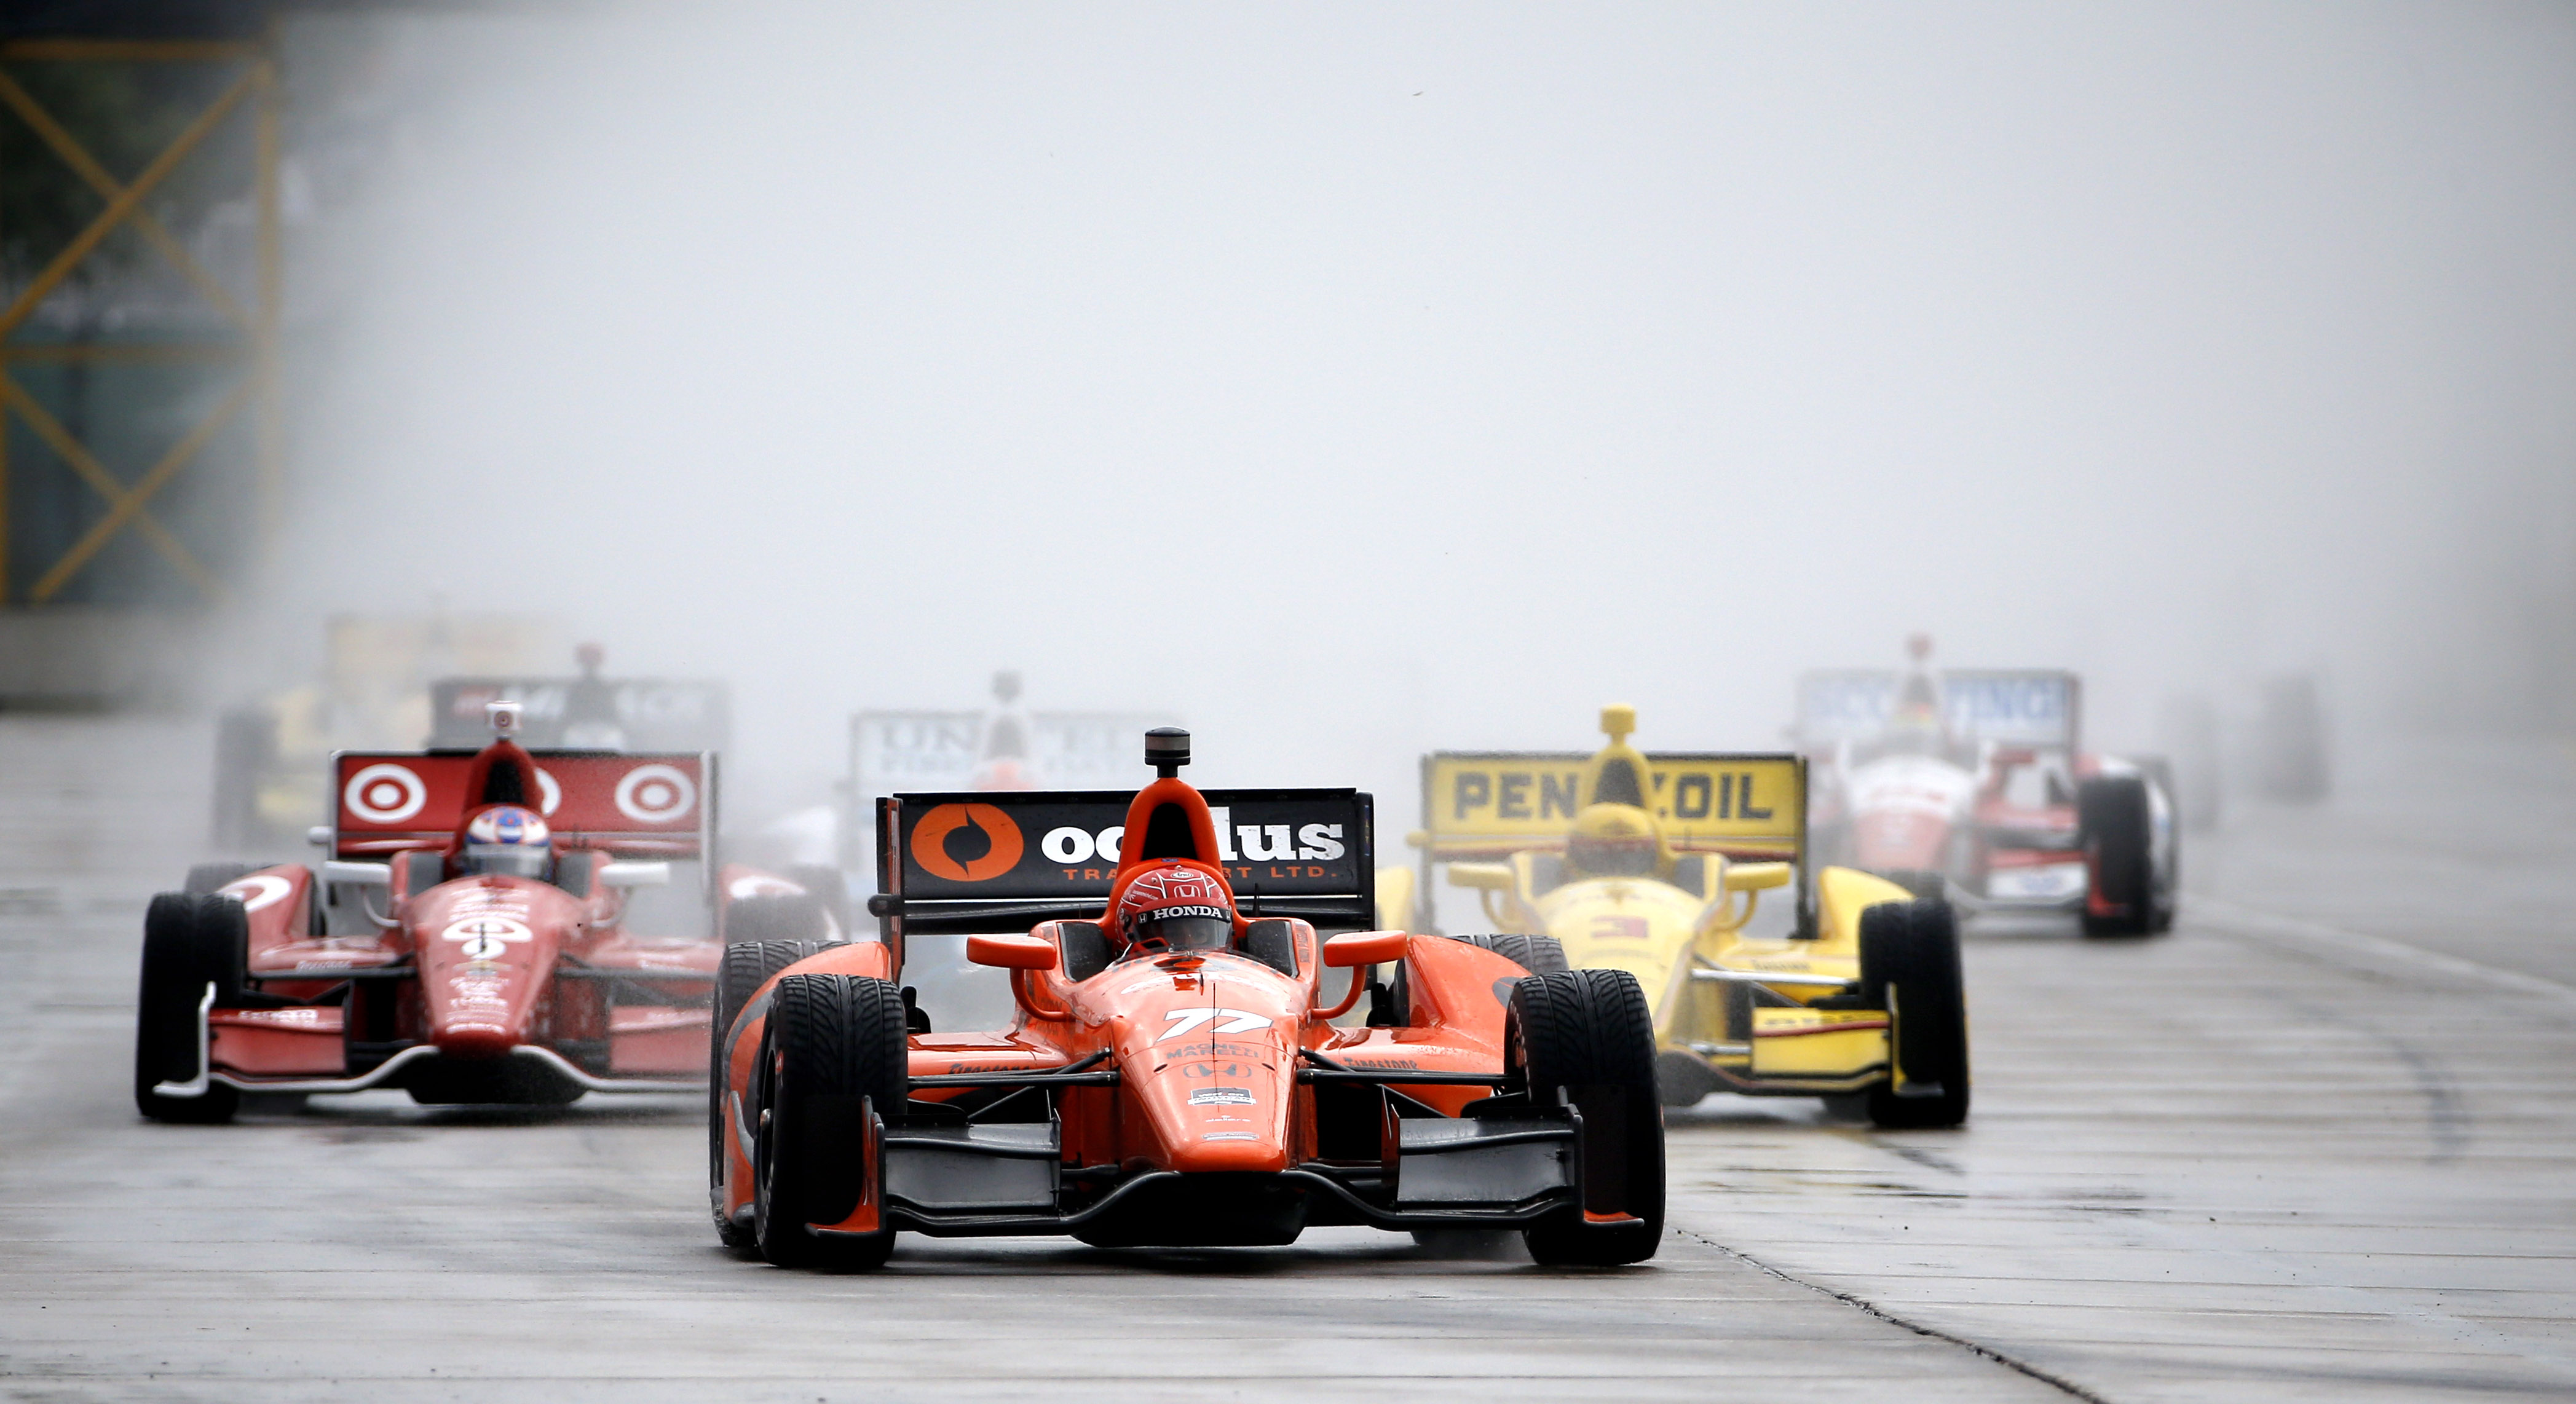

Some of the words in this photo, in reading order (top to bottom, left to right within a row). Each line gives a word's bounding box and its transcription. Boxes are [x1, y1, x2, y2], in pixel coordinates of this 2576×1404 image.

[1455, 772, 1774, 819] PENOIL
[1041, 807, 1345, 864] oclus
[1270, 866, 1337, 878] LTD.
[1153, 905, 1223, 921] HONDA
[1155, 1008, 1273, 1043] 77
